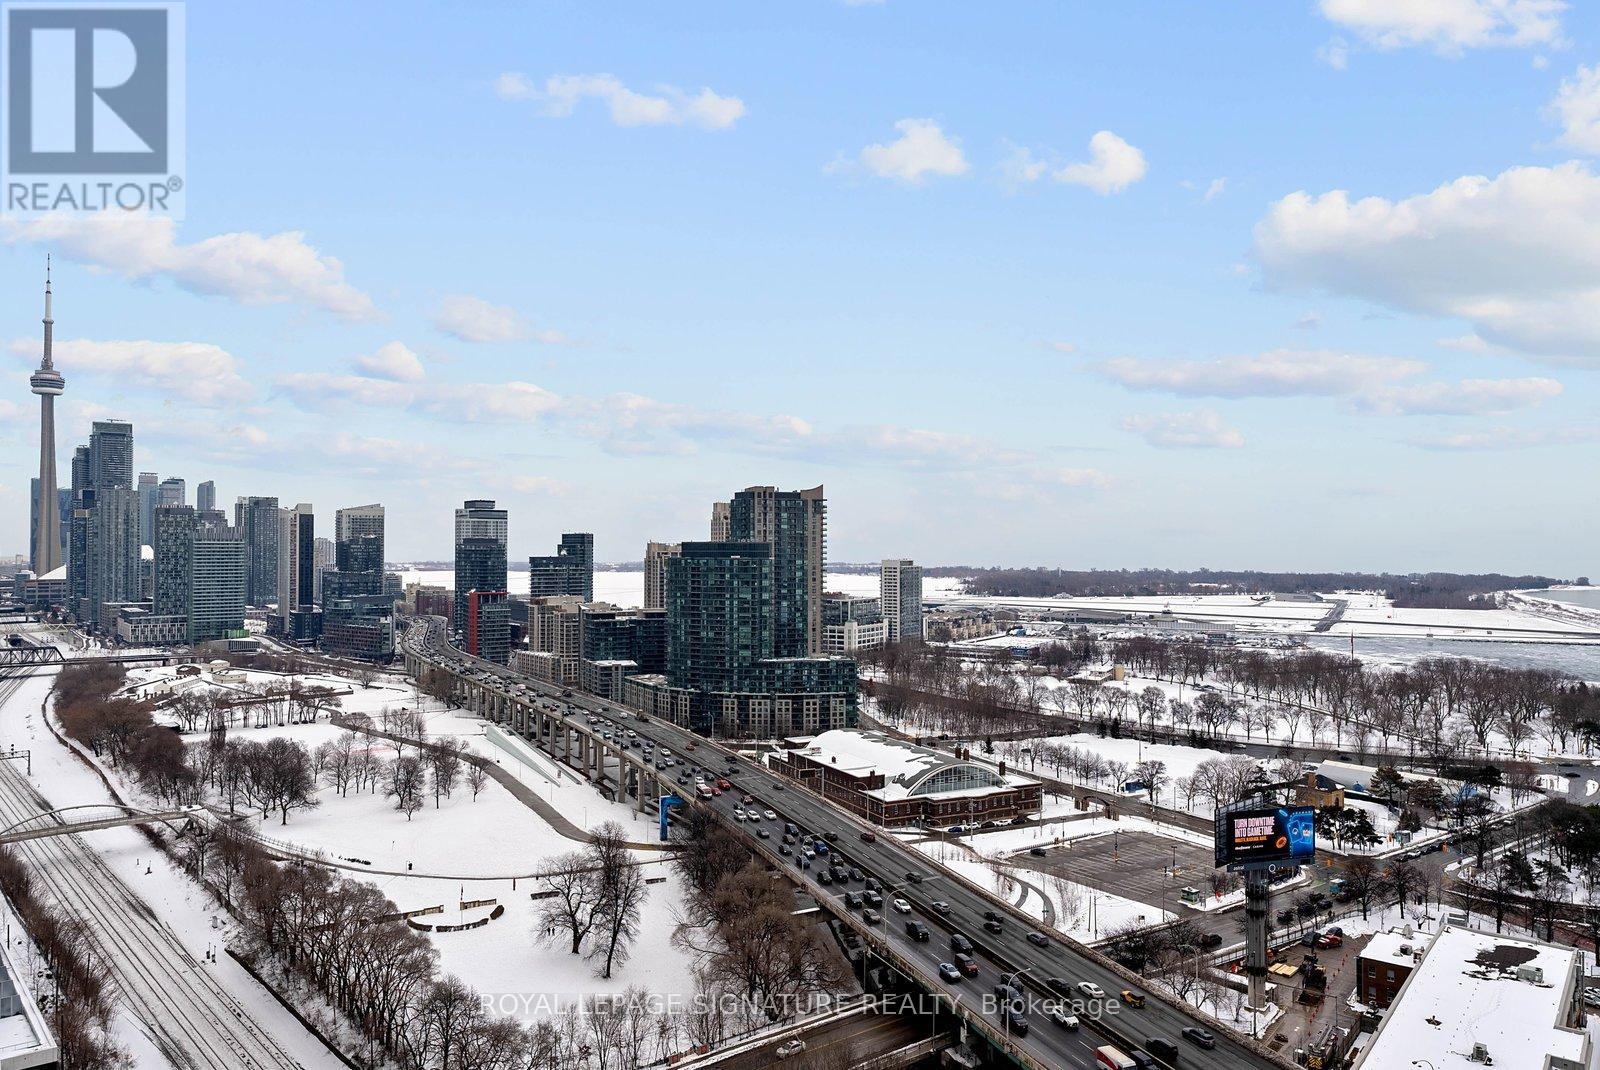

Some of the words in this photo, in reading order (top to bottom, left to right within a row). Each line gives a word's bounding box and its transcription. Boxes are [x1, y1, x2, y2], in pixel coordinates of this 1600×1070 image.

[1234, 818, 1247, 828] TURN
[1248, 816, 1275, 827] DOWNTIME
[1235, 828, 1246, 838] INTO
